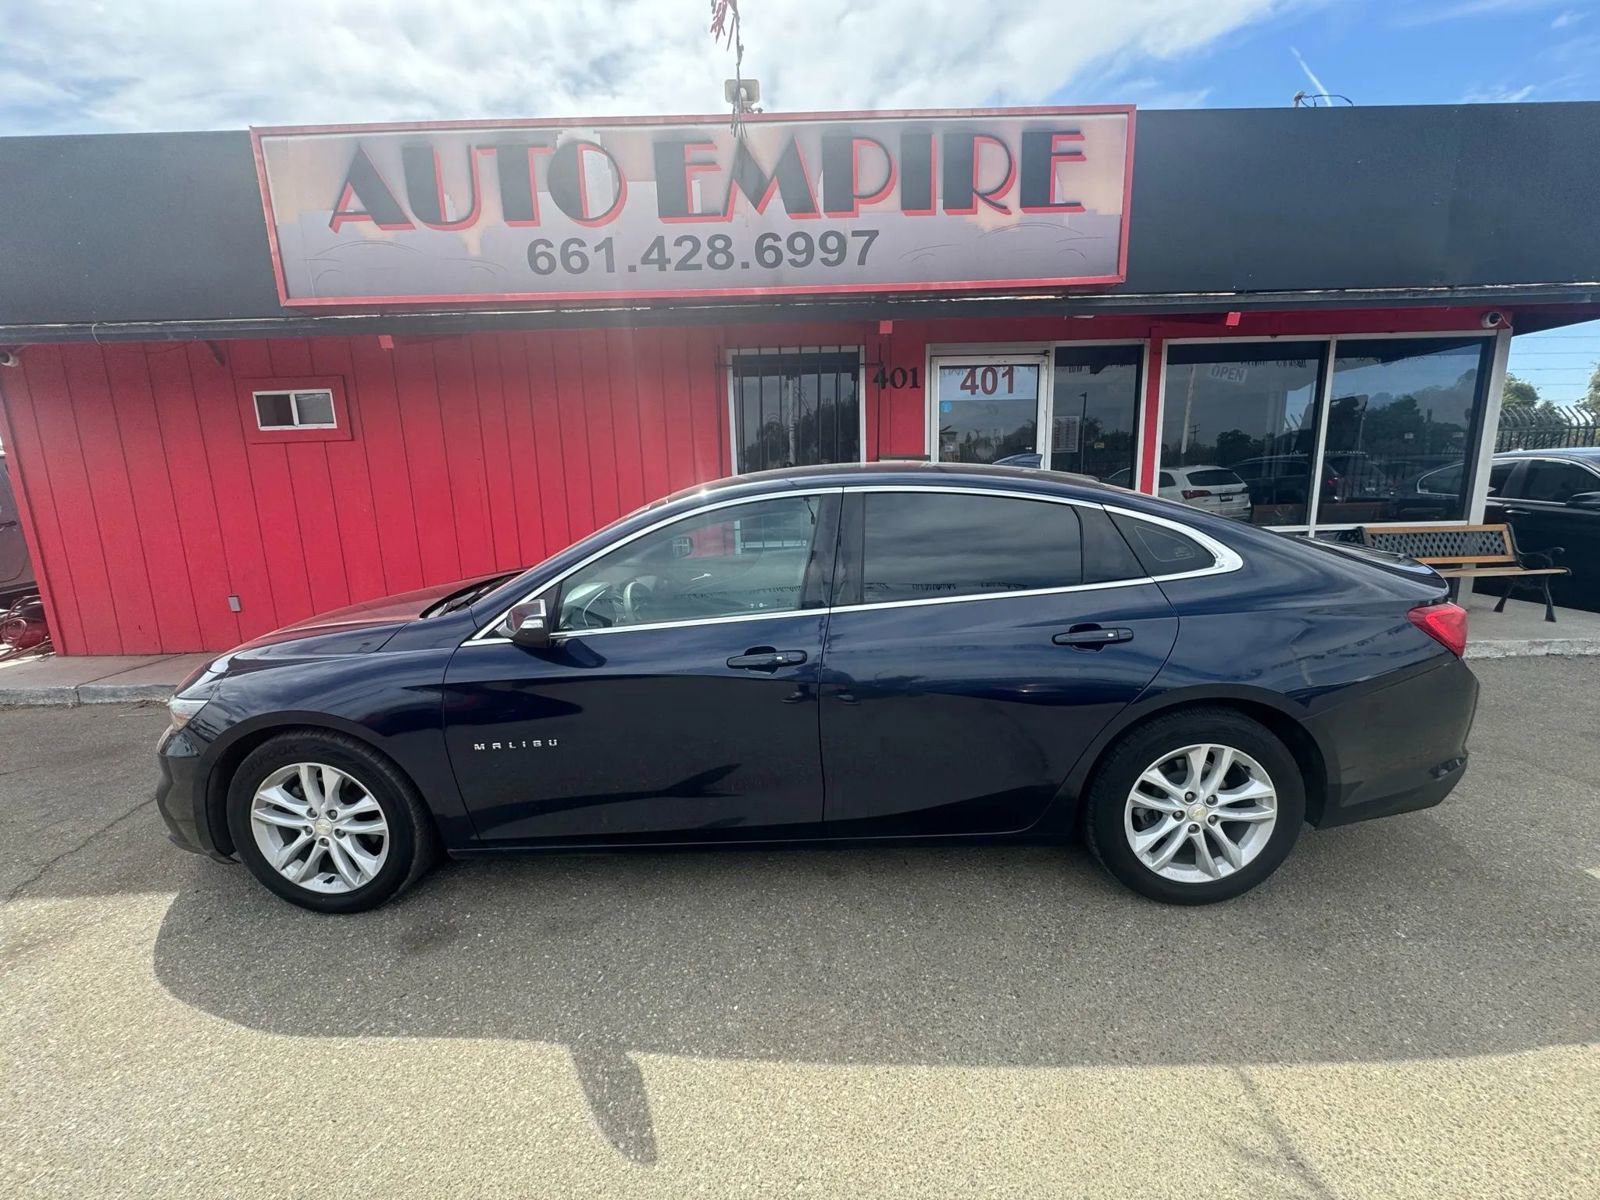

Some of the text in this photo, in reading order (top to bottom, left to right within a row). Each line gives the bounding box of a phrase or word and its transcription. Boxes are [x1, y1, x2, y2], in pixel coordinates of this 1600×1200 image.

[329, 130, 1087, 233] AUTO EMPIRE
[527, 230, 878, 276] 661.428.6997
[872, 366, 921, 390] 401
[960, 366, 1013, 396] 401
[1211, 364, 1245, 382] OPEN
[473, 738, 559, 751] MALIBU
